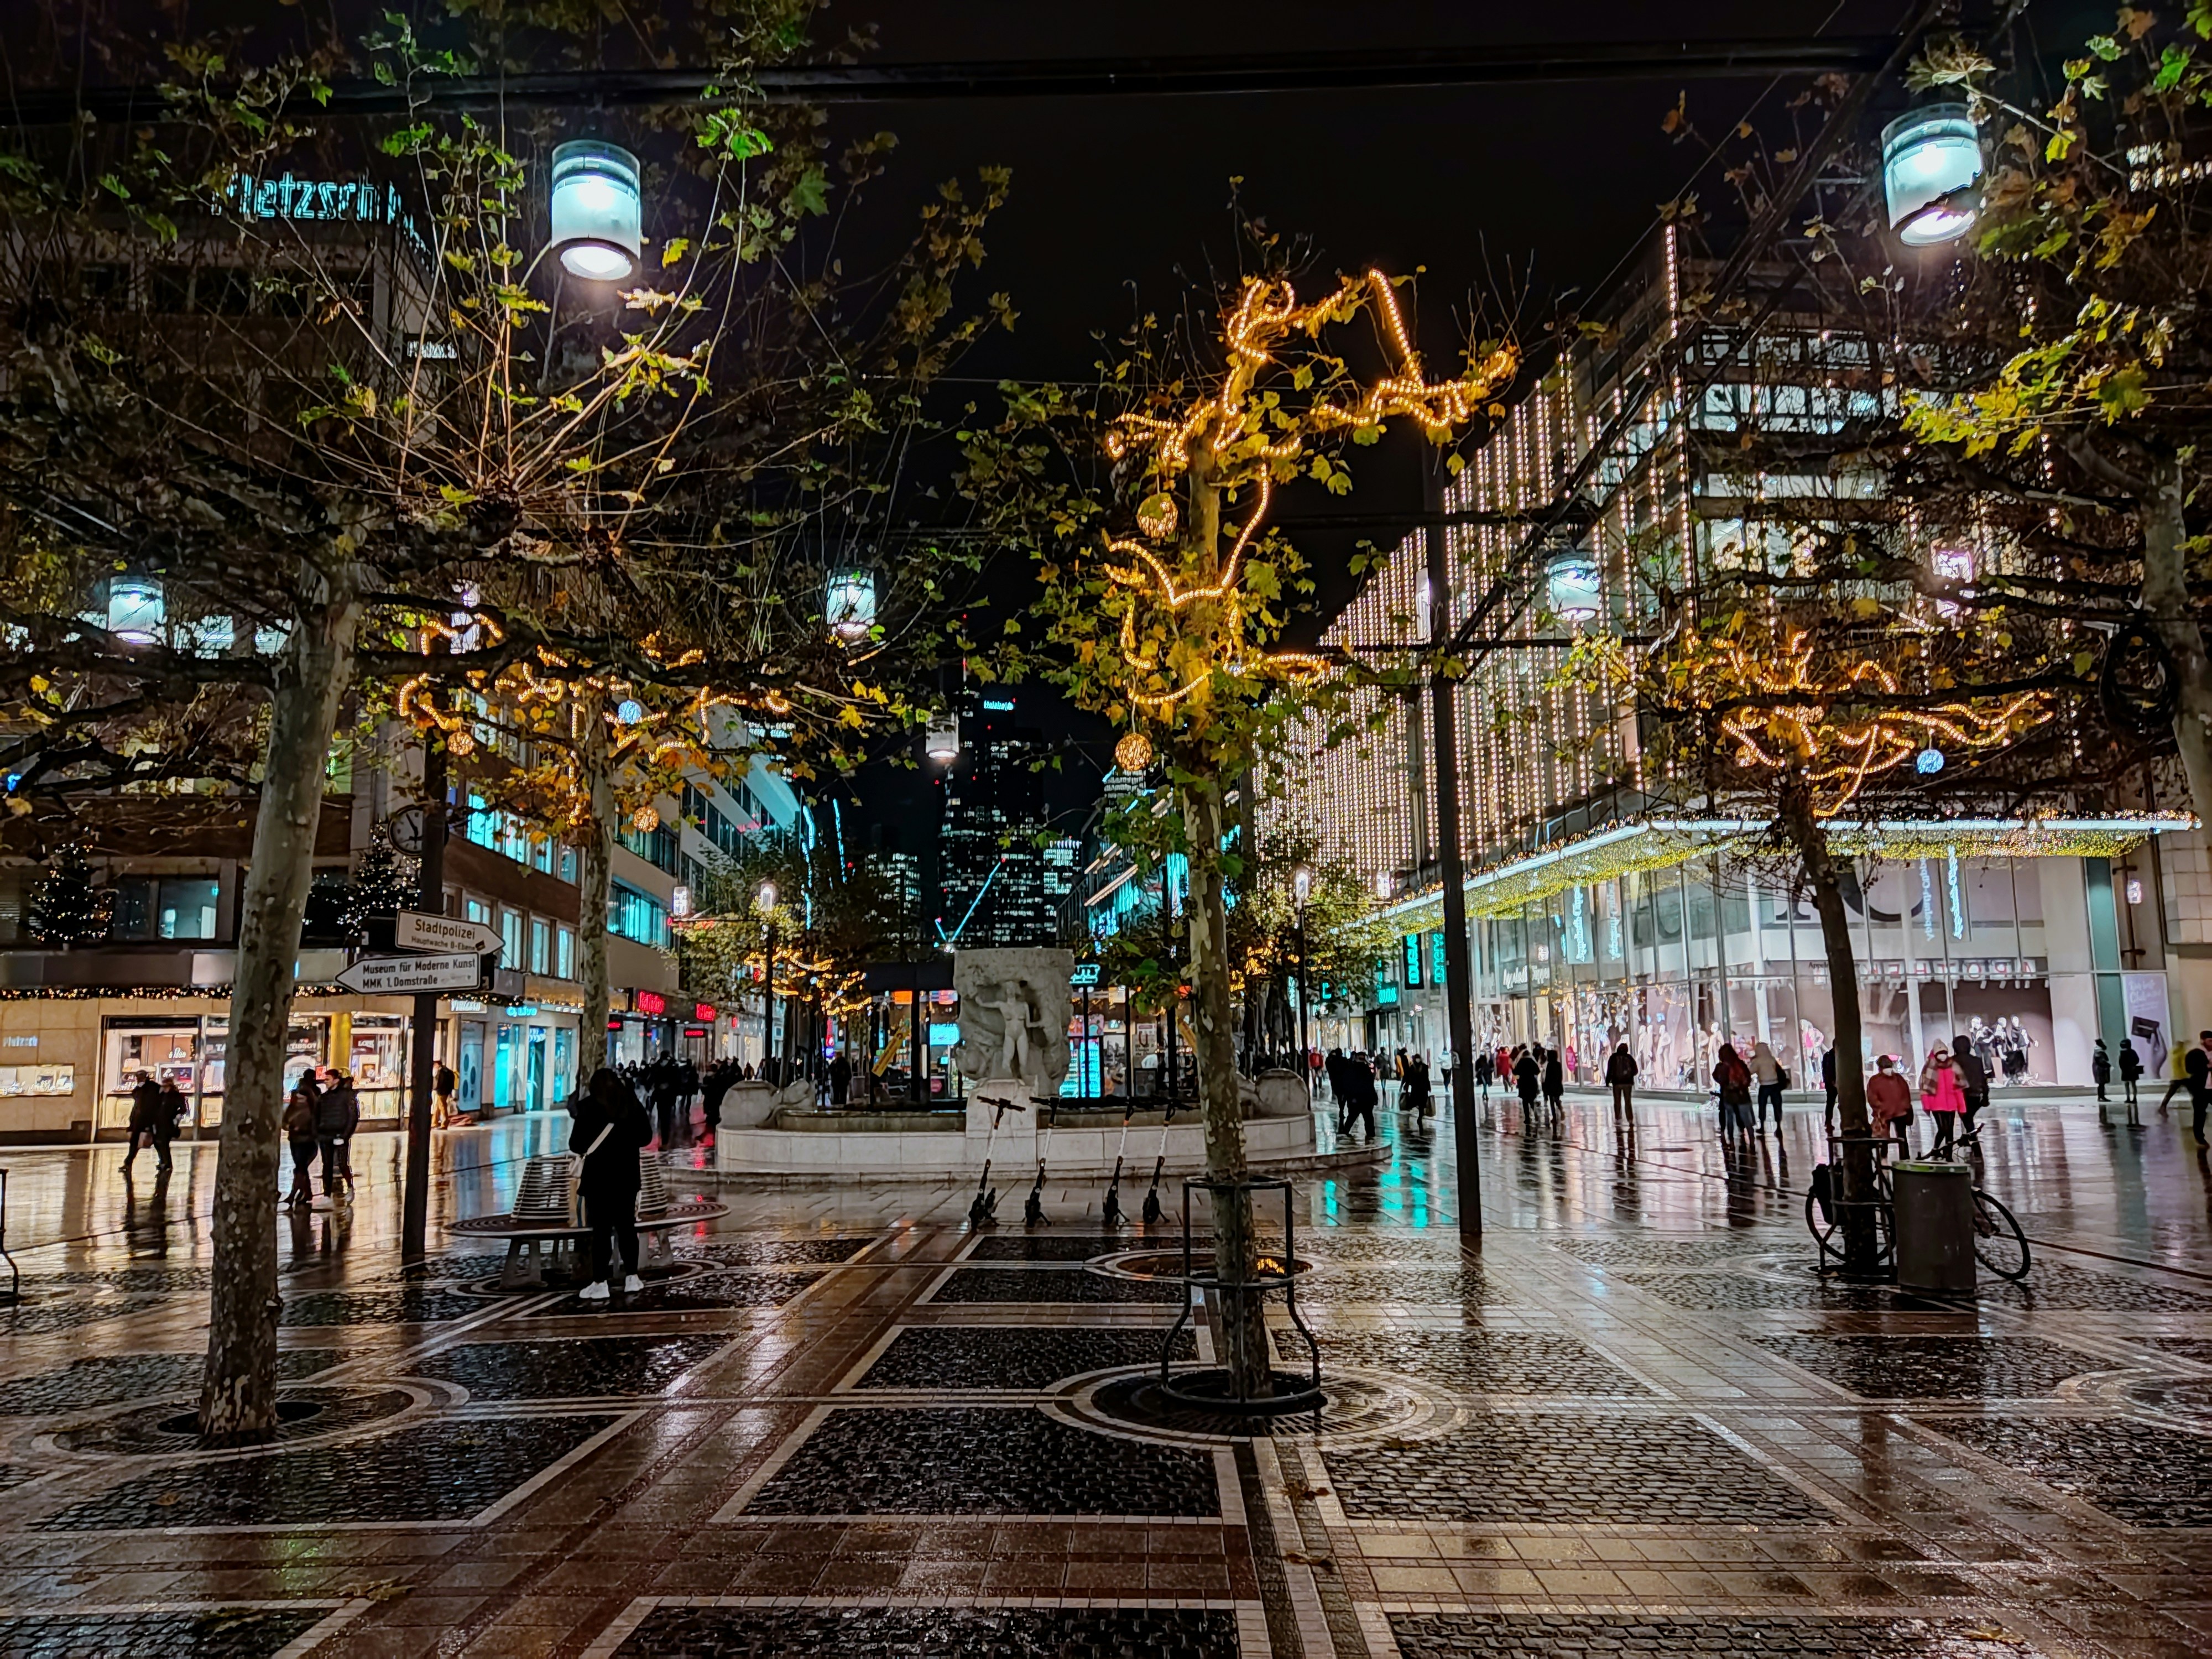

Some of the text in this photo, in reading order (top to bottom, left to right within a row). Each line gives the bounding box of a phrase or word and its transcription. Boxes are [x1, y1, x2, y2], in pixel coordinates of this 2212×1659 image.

[415, 919, 476, 940] Stadtpolizei
[411, 936, 448, 947] Hauptwache
[363, 958, 476, 974] Museum für Moderne Kunst
[362, 978, 382, 989] MMK
[394, 975, 438, 987] Domstraße
